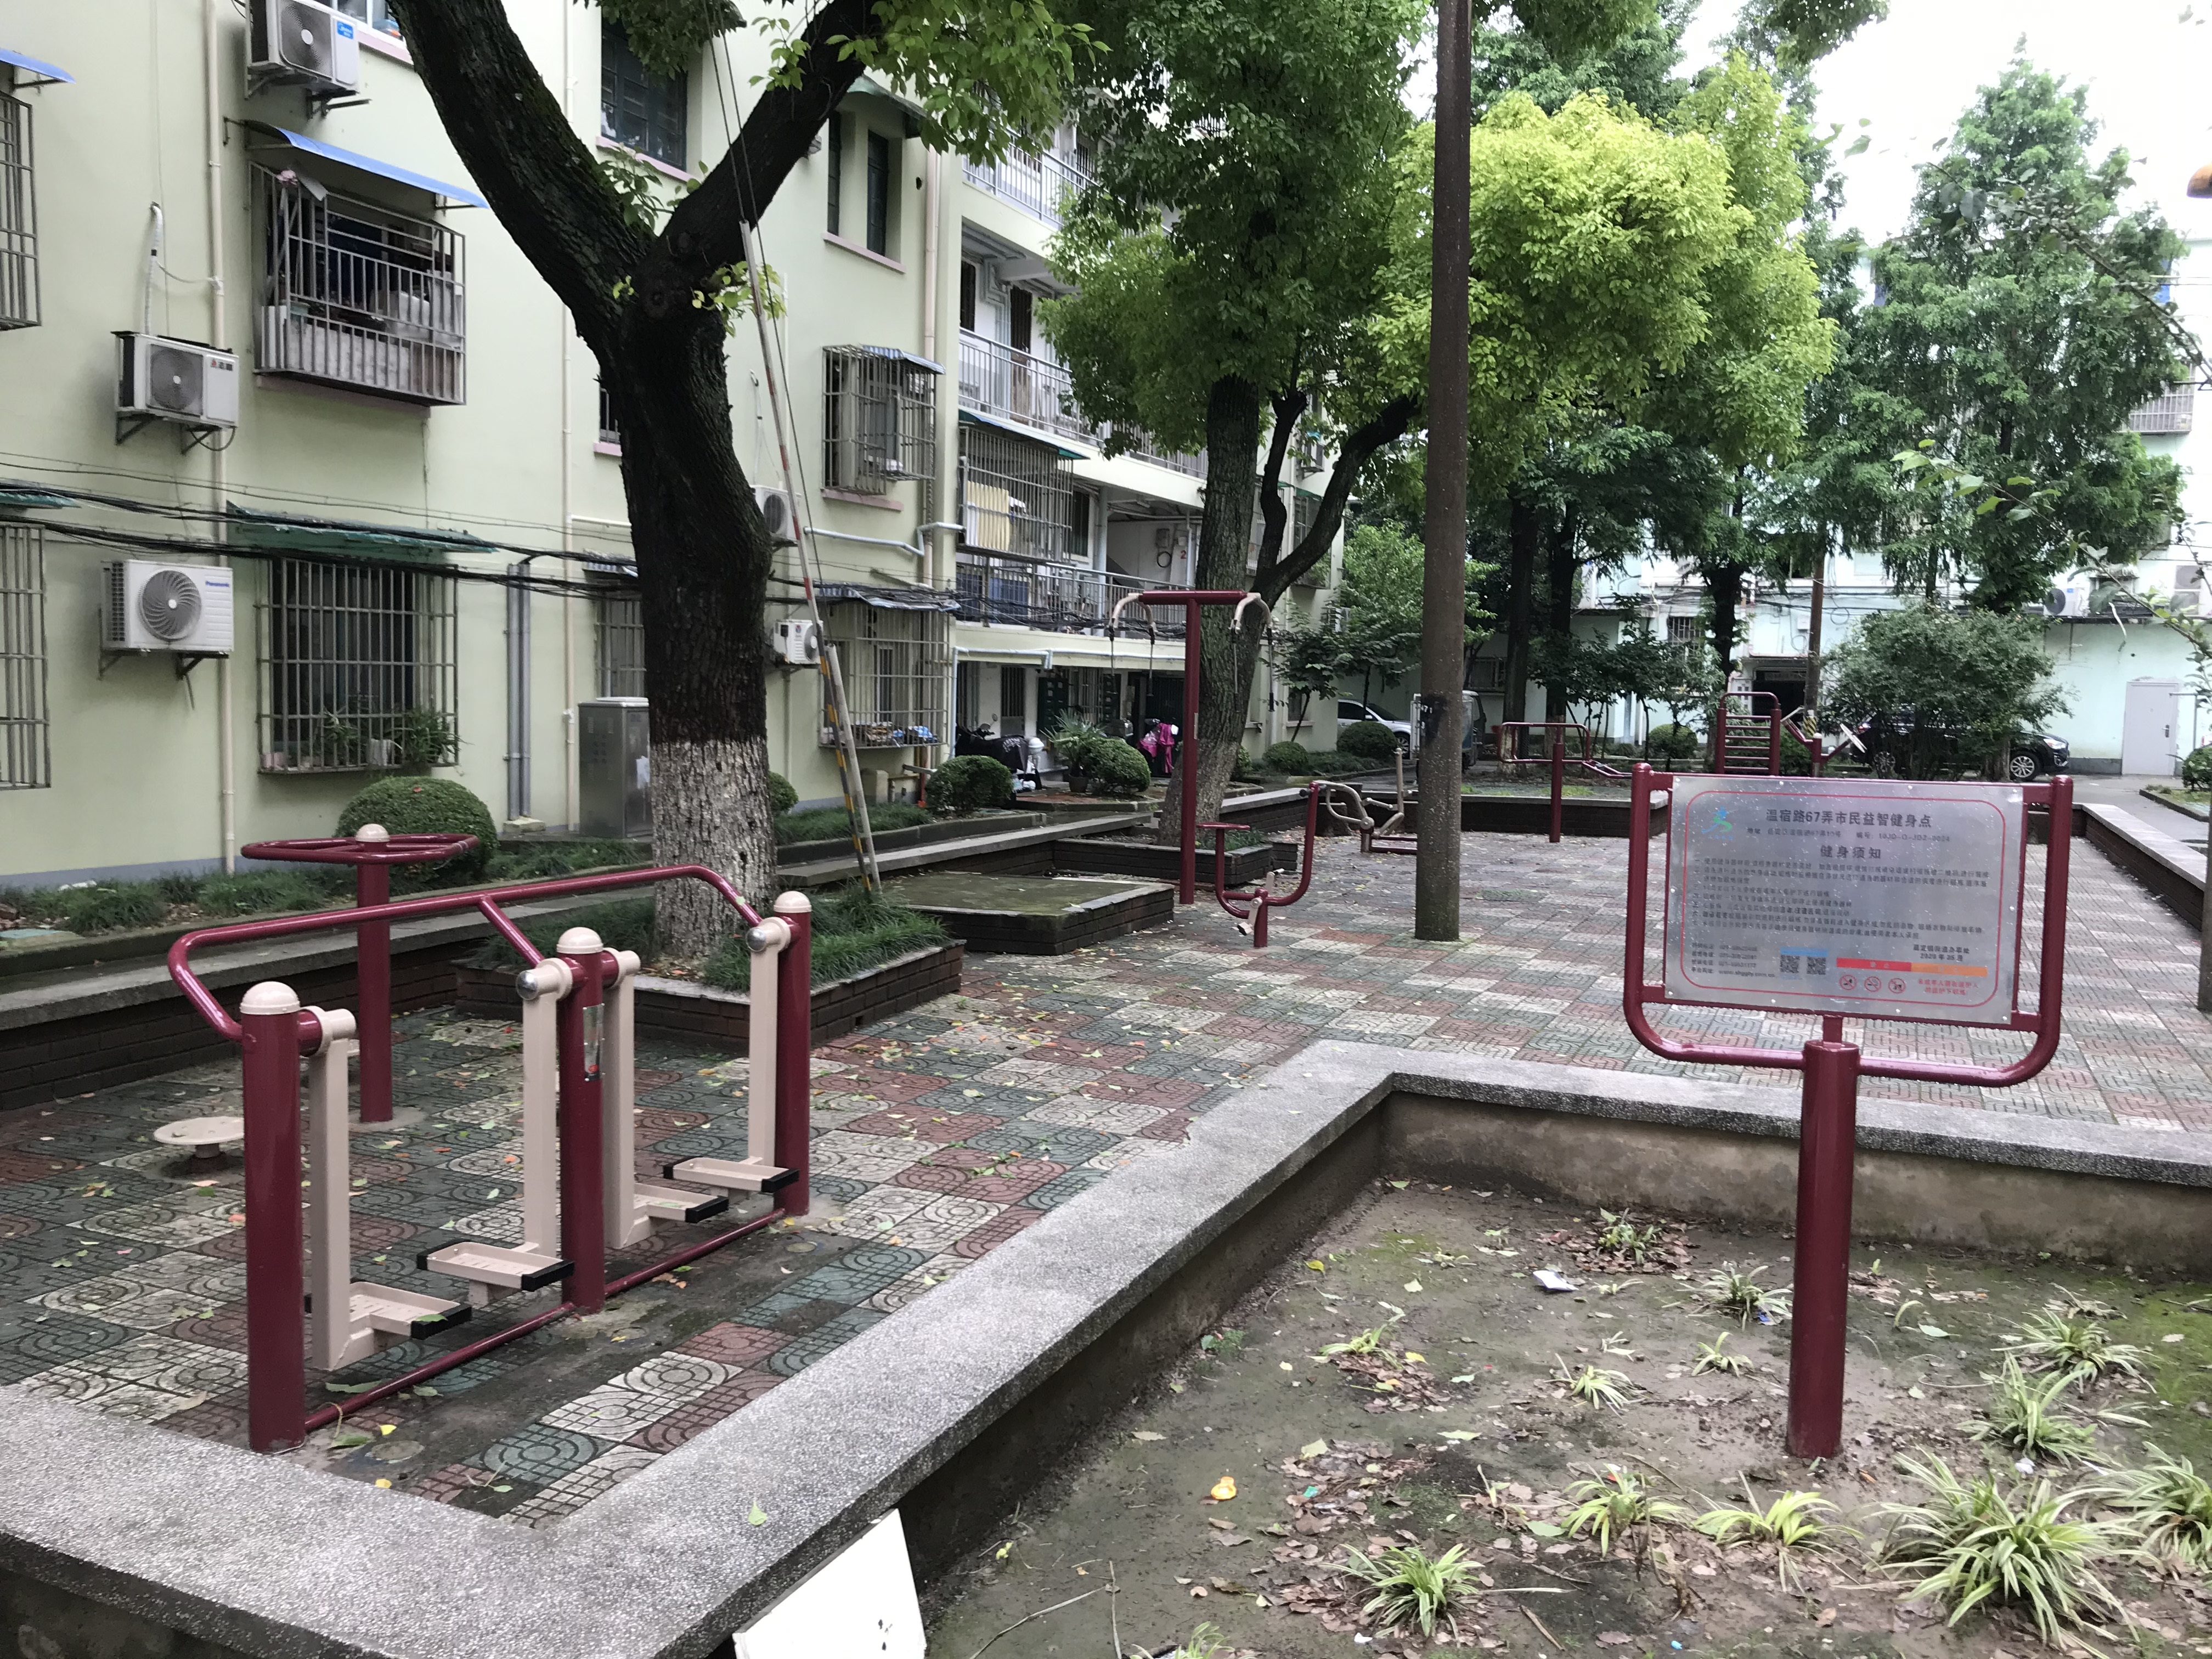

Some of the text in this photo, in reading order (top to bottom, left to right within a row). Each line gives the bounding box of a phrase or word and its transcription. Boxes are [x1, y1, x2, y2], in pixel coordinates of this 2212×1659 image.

[1180, 550, 1187, 560] 2
[1766, 808, 1932, 828] 温宿路67弄市民益智健身点
[1820, 845, 1881, 860] 健身须知
